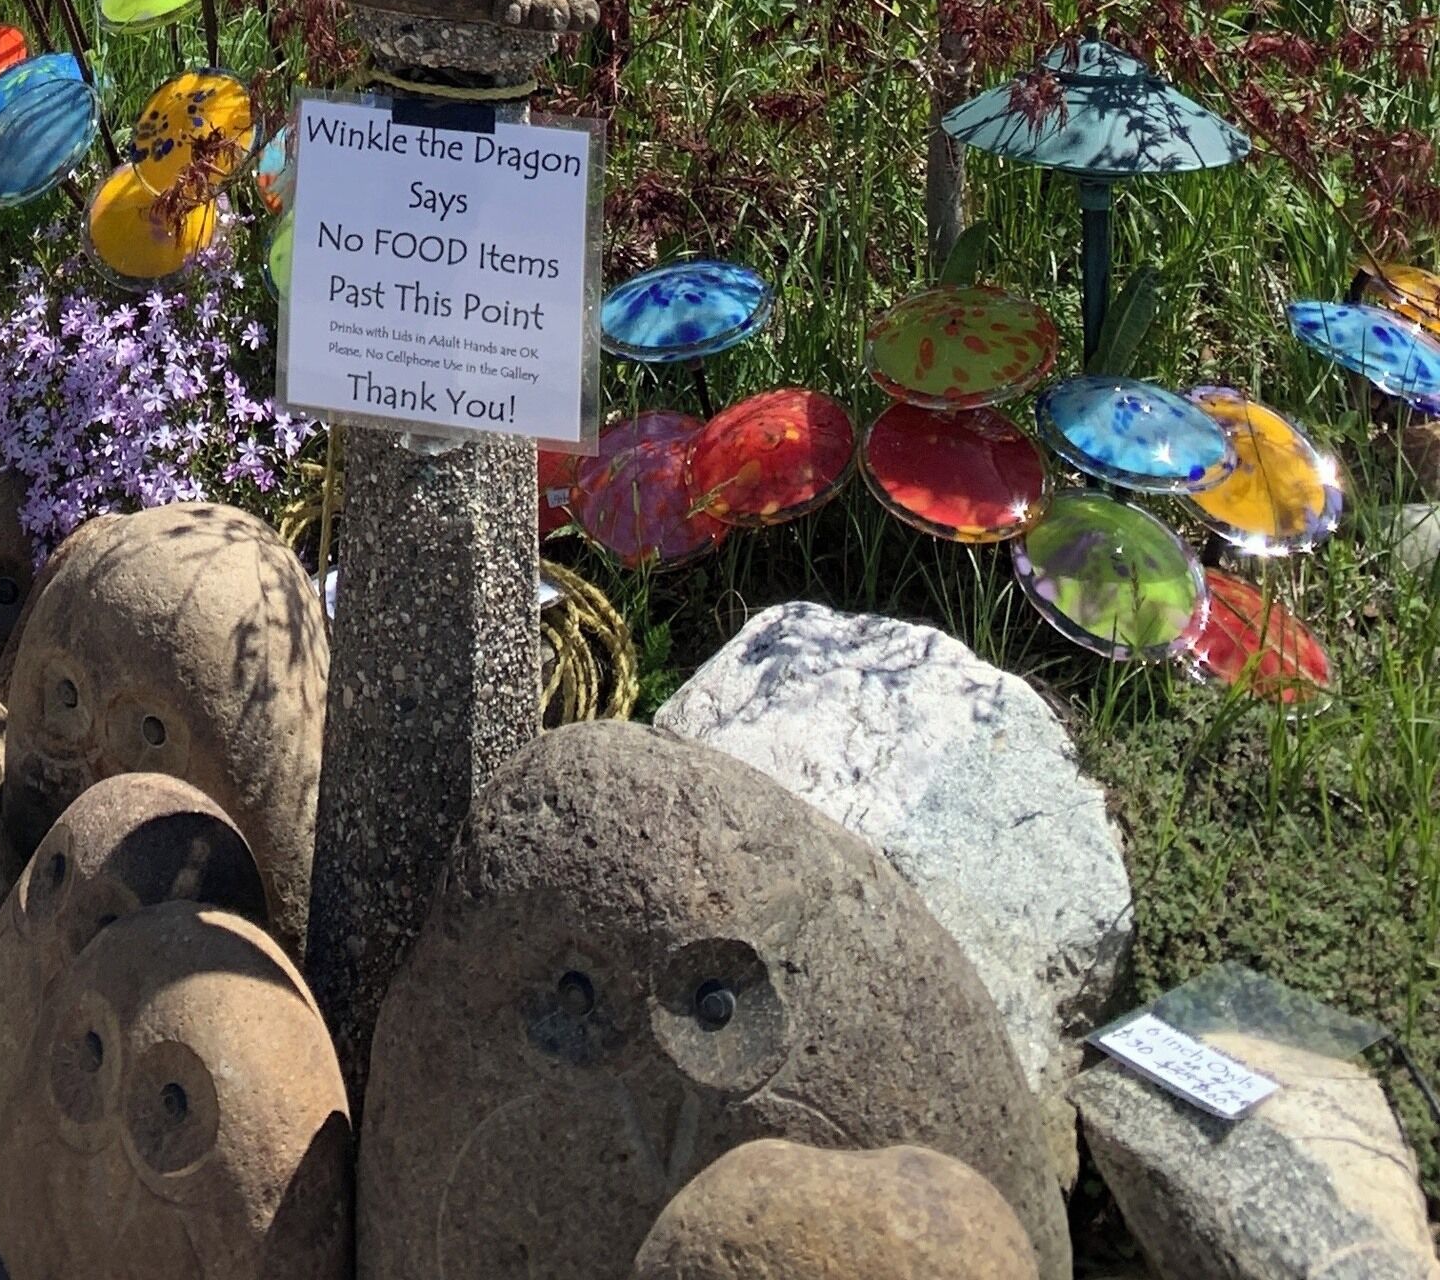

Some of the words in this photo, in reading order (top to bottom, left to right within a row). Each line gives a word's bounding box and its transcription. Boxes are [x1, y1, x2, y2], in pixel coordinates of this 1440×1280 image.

[307, 115, 407, 154] Winkle
[415, 130, 463, 161] the
[474, 136, 581, 180] Dragon
[409, 181, 468, 222] Says
[318, 221, 364, 252] No
[375, 228, 468, 266] FOOD
[479, 242, 559, 279] Items
[329, 275, 386, 309] Past
[394, 280, 452, 317] This
[464, 293, 544, 330] Point
[330, 321, 363, 335] Drinks
[365, 326, 389, 339] with
[392, 329, 413, 342] Lids
[415, 334, 426, 345] in
[428, 335, 460, 349] Adult
[464, 338, 498, 354] Hands
[500, 346, 517, 357] are
[519, 347, 539, 359] OK
[366, 348, 383, 360] No
[386, 350, 440, 368] Cellphone
[443, 358, 463, 371] Use
[466, 364, 476, 373] in
[480, 362, 498, 376] the
[500, 366, 540, 385] Gallery
[347, 370, 437, 412] Thank
[445, 388, 515, 424] You!
